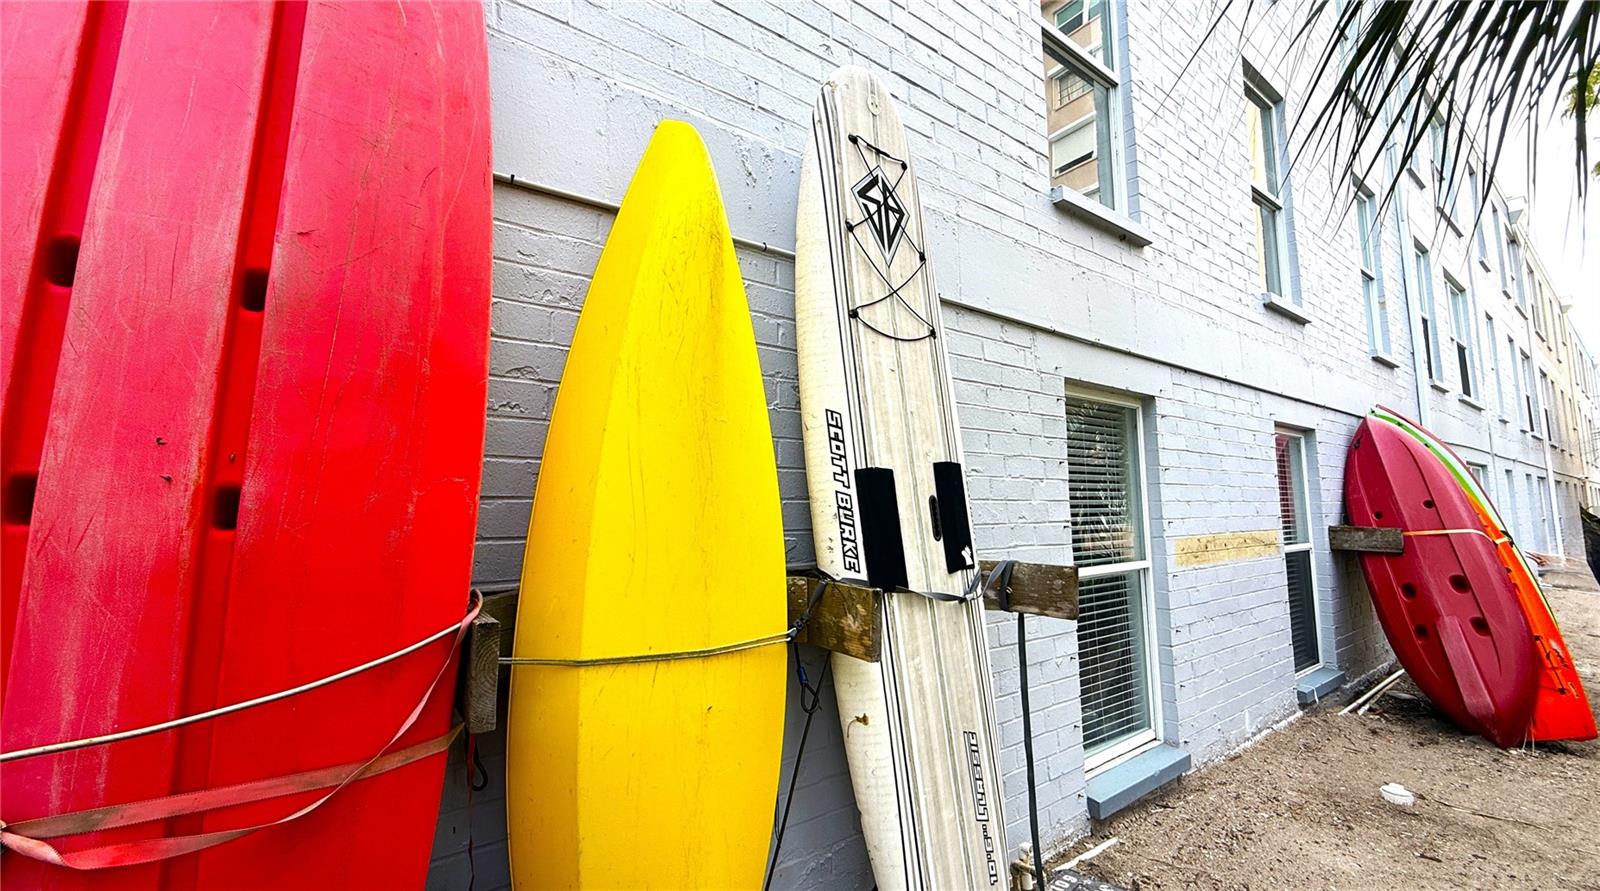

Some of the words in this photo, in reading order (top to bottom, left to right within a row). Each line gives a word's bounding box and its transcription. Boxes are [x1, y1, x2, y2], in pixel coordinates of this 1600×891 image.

[825, 409, 850, 489] SCOTT
[835, 490, 860, 573] BURKE
[963, 731, 989, 821] CLASSIC
